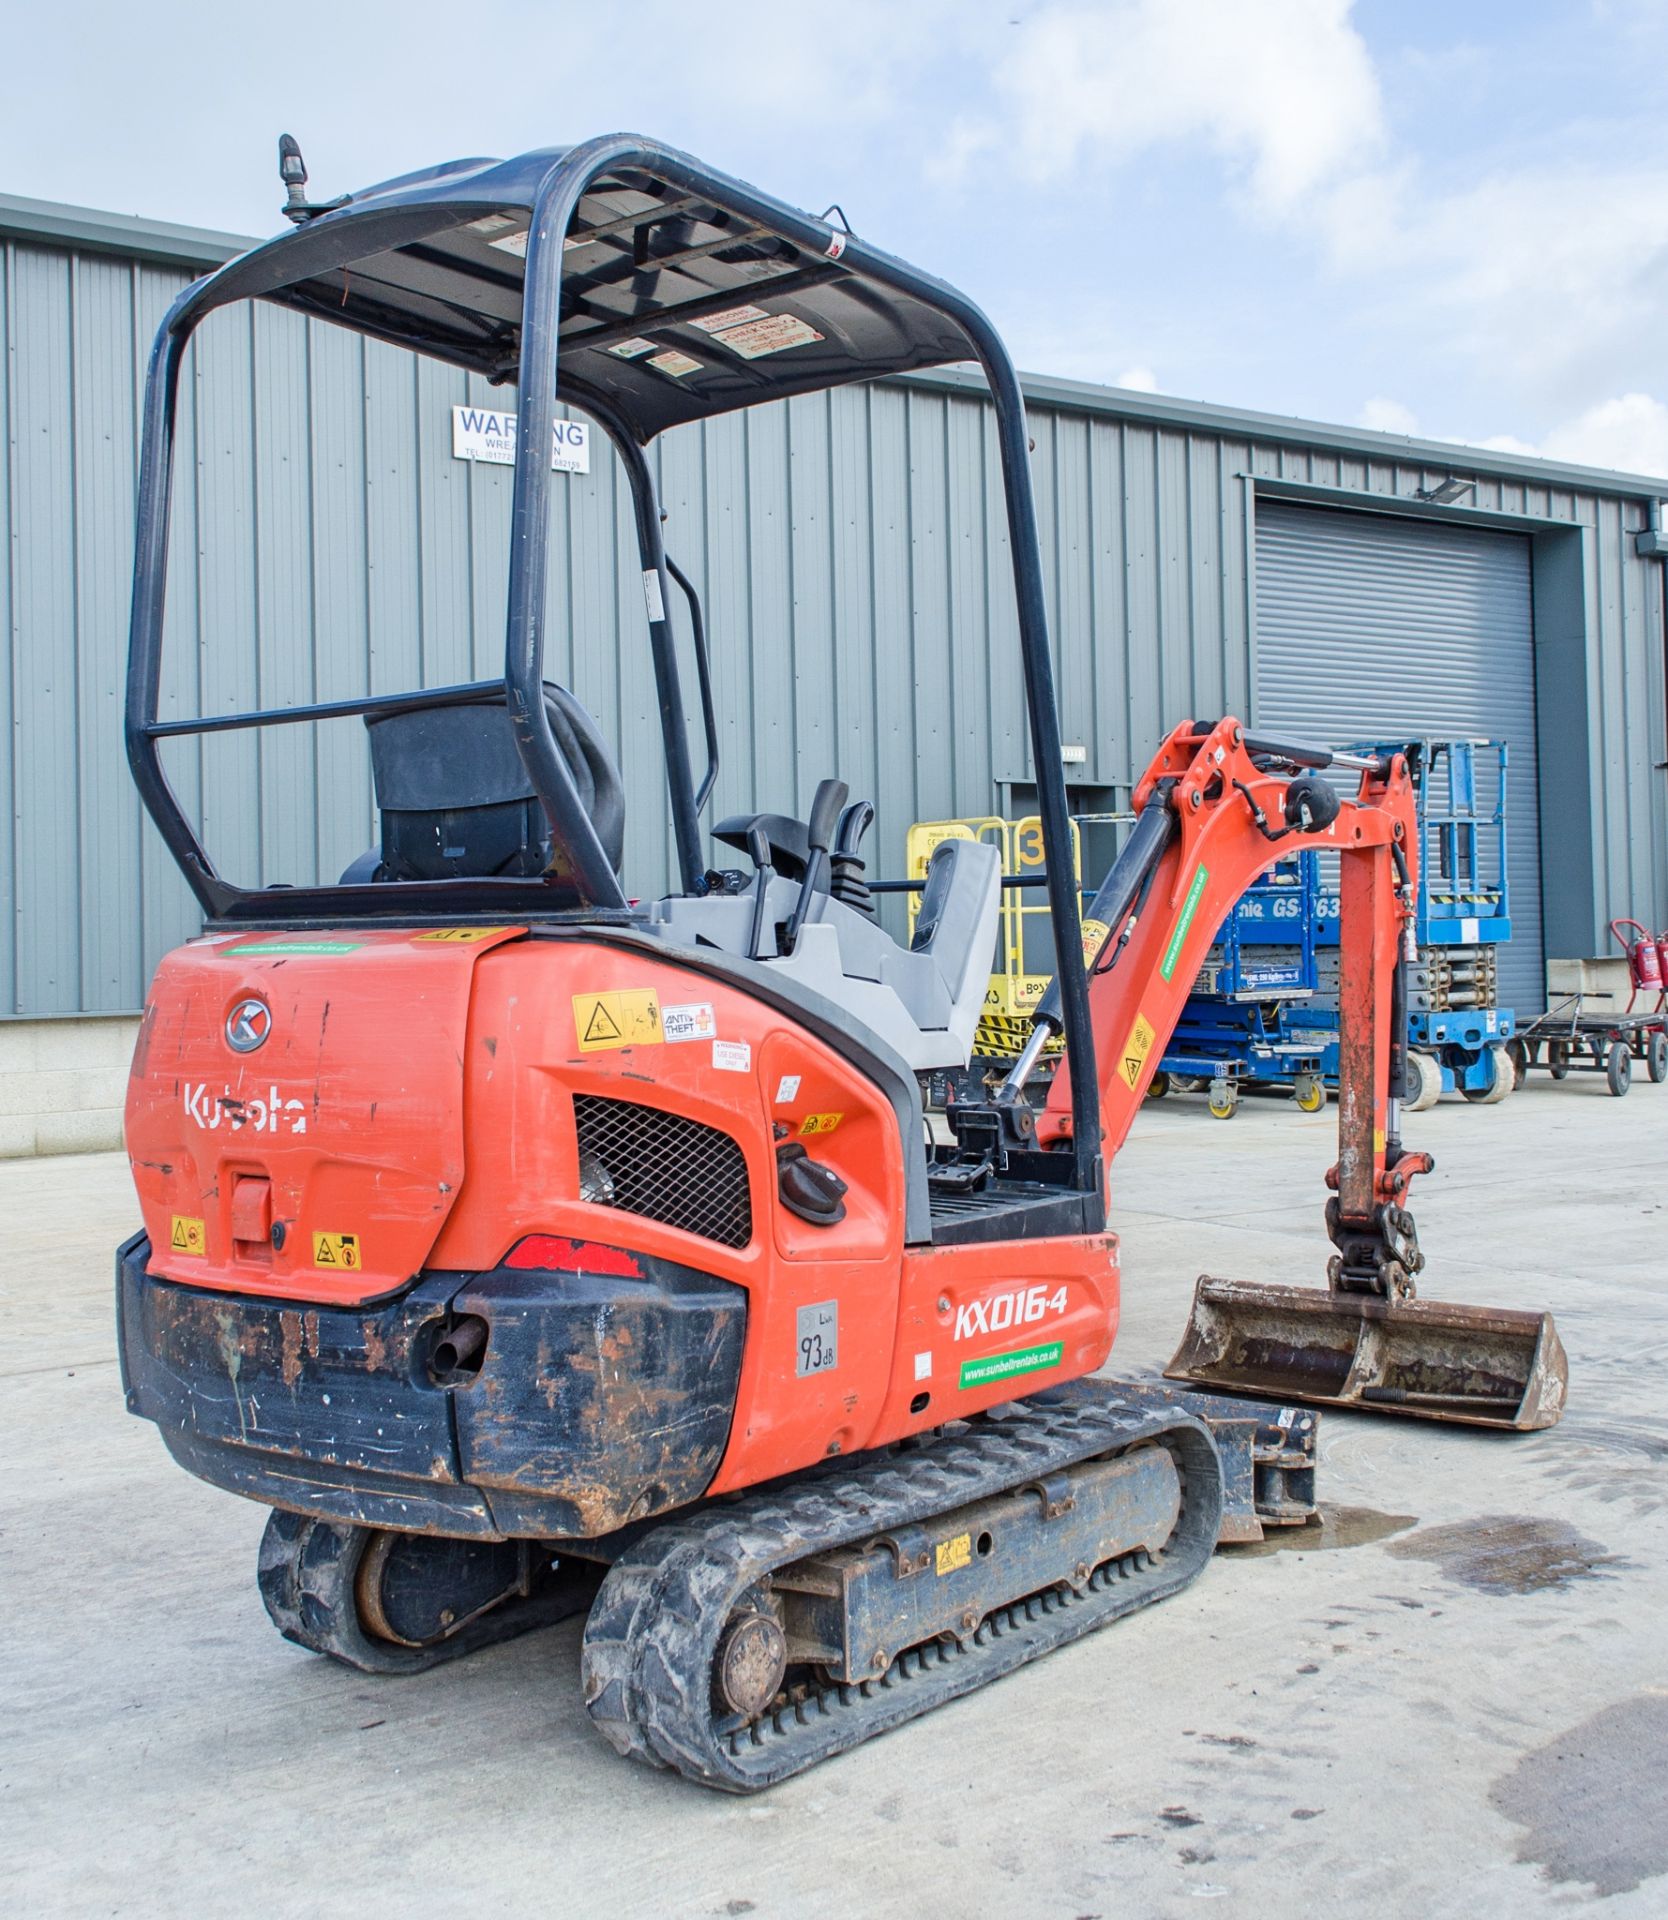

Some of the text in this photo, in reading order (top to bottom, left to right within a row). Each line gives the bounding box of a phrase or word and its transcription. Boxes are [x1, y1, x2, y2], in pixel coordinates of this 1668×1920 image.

[461, 409, 584, 447] WARNG
[485, 438, 517, 450] WRE
[1019, 824, 1044, 867] 3
[1238, 899, 1263, 918] nie
[664, 1023, 695, 1035] THEFT
[801, 1333, 822, 1371] 93
[963, 1346, 1060, 1382] www.sunbeltrentals.co.uk
